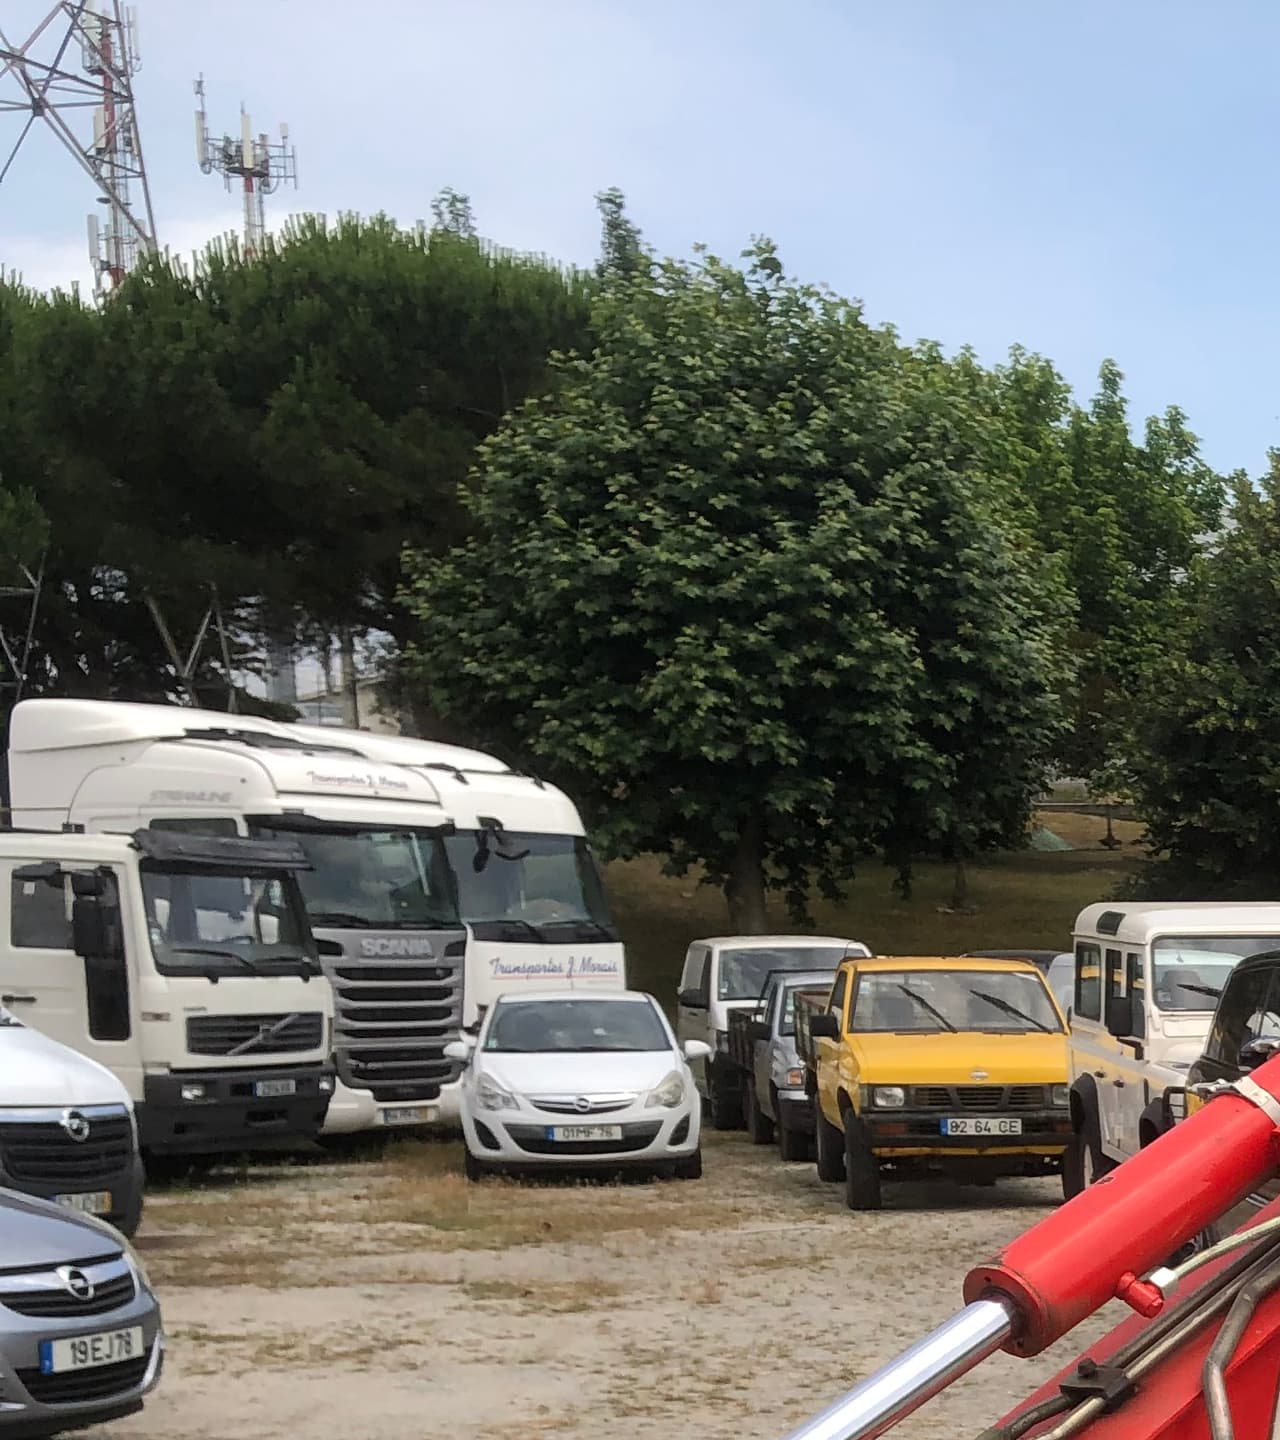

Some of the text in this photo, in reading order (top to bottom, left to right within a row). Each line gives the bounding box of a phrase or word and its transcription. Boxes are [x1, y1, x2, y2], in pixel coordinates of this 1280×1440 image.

[361, 938, 433, 956] SCANIA
[489, 957, 563, 979] Transportes
[579, 956, 618, 973] Morais
